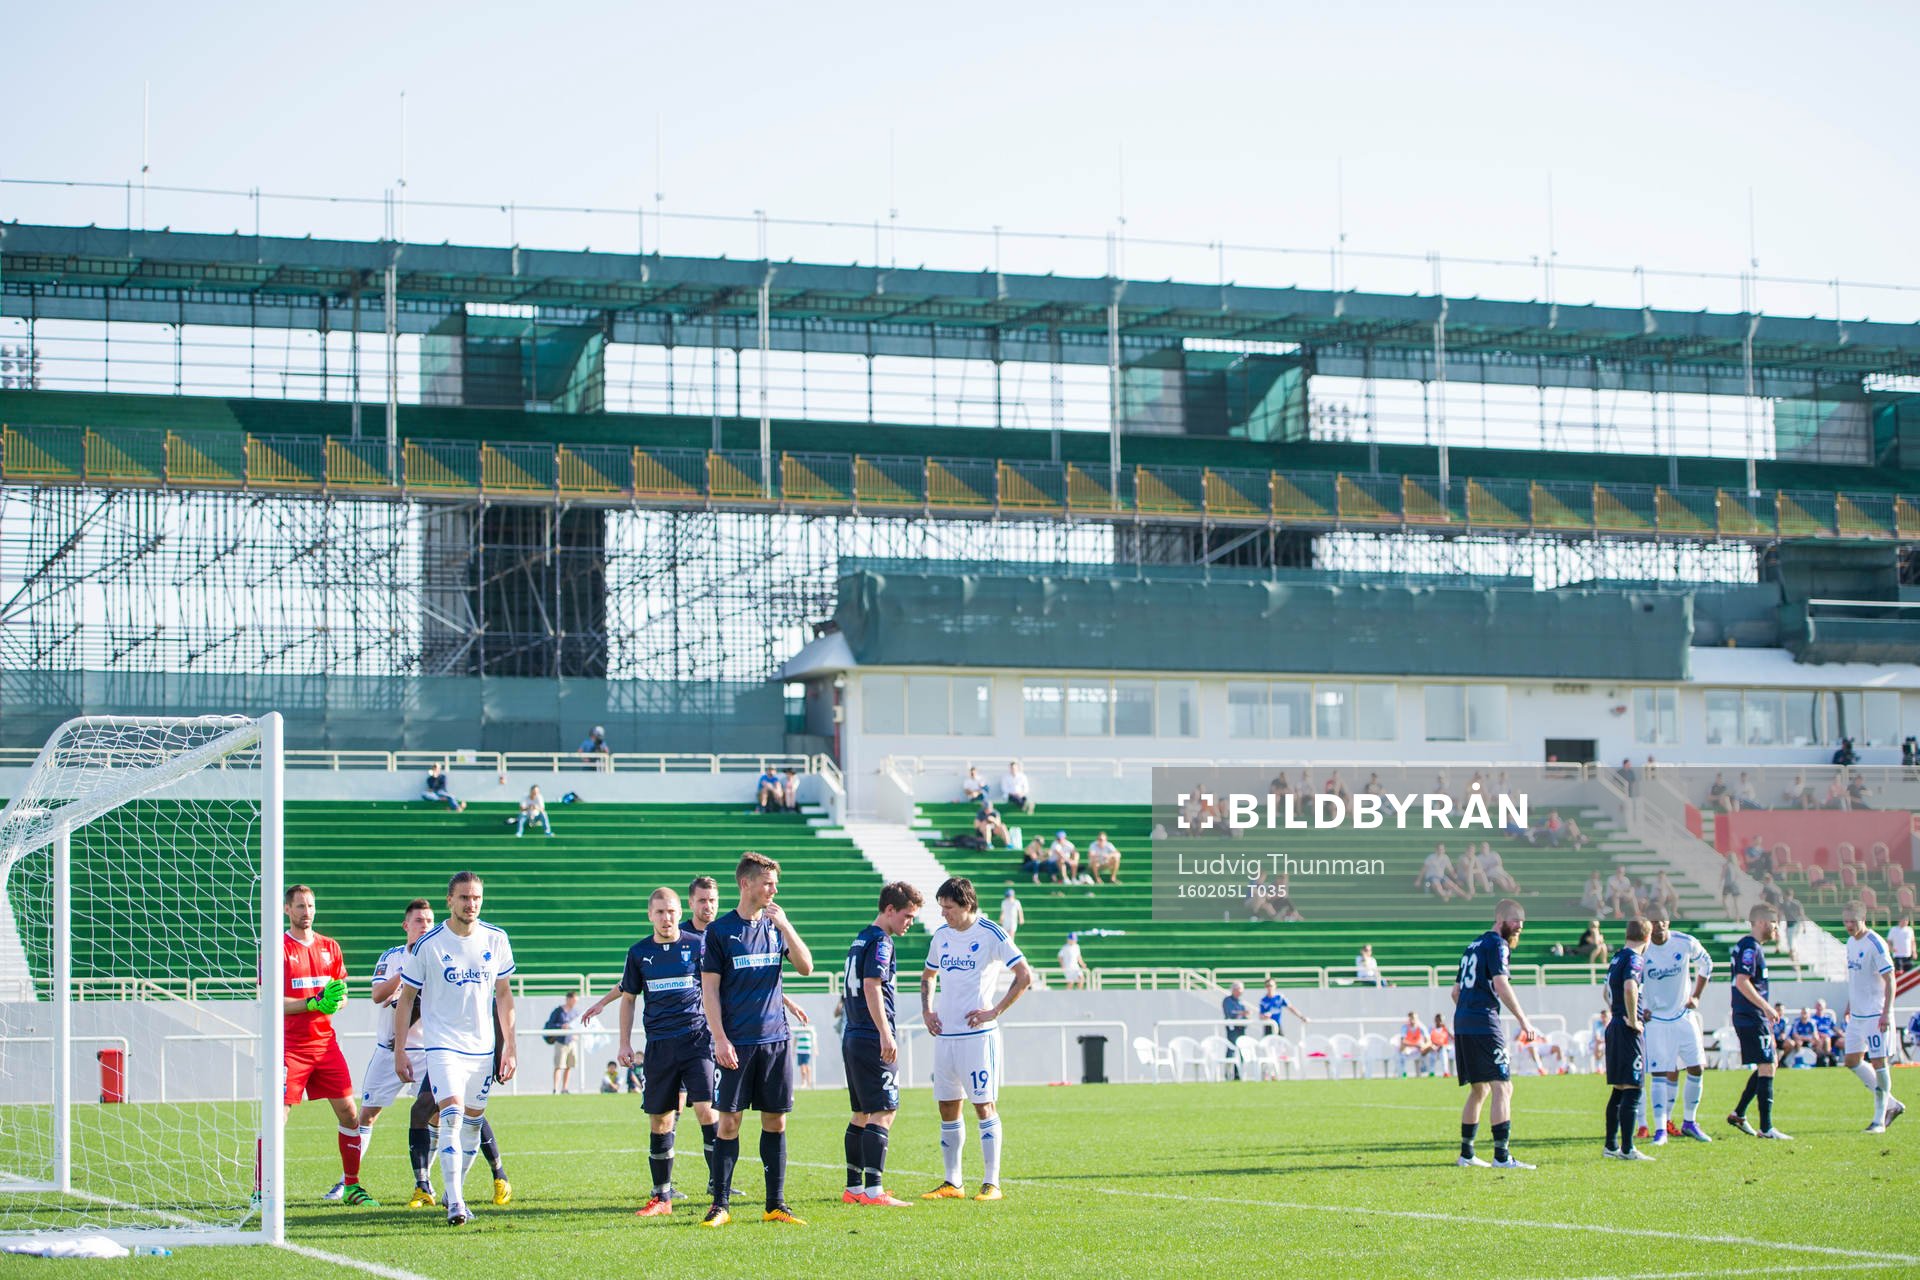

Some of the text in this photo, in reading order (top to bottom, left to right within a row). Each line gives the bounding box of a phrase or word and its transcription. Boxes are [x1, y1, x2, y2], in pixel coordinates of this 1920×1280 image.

[940, 954, 976, 970] Carlsberg
[444, 966, 490, 984] Carlsberg
[1759, 1035, 1771, 1050] 17
[1867, 1034, 1881, 1049] 10
[1632, 1055, 1643, 1071] 6
[481, 1075, 492, 1094] 5
[714, 1068, 722, 1089] 9
[970, 1070, 989, 1089] 19
